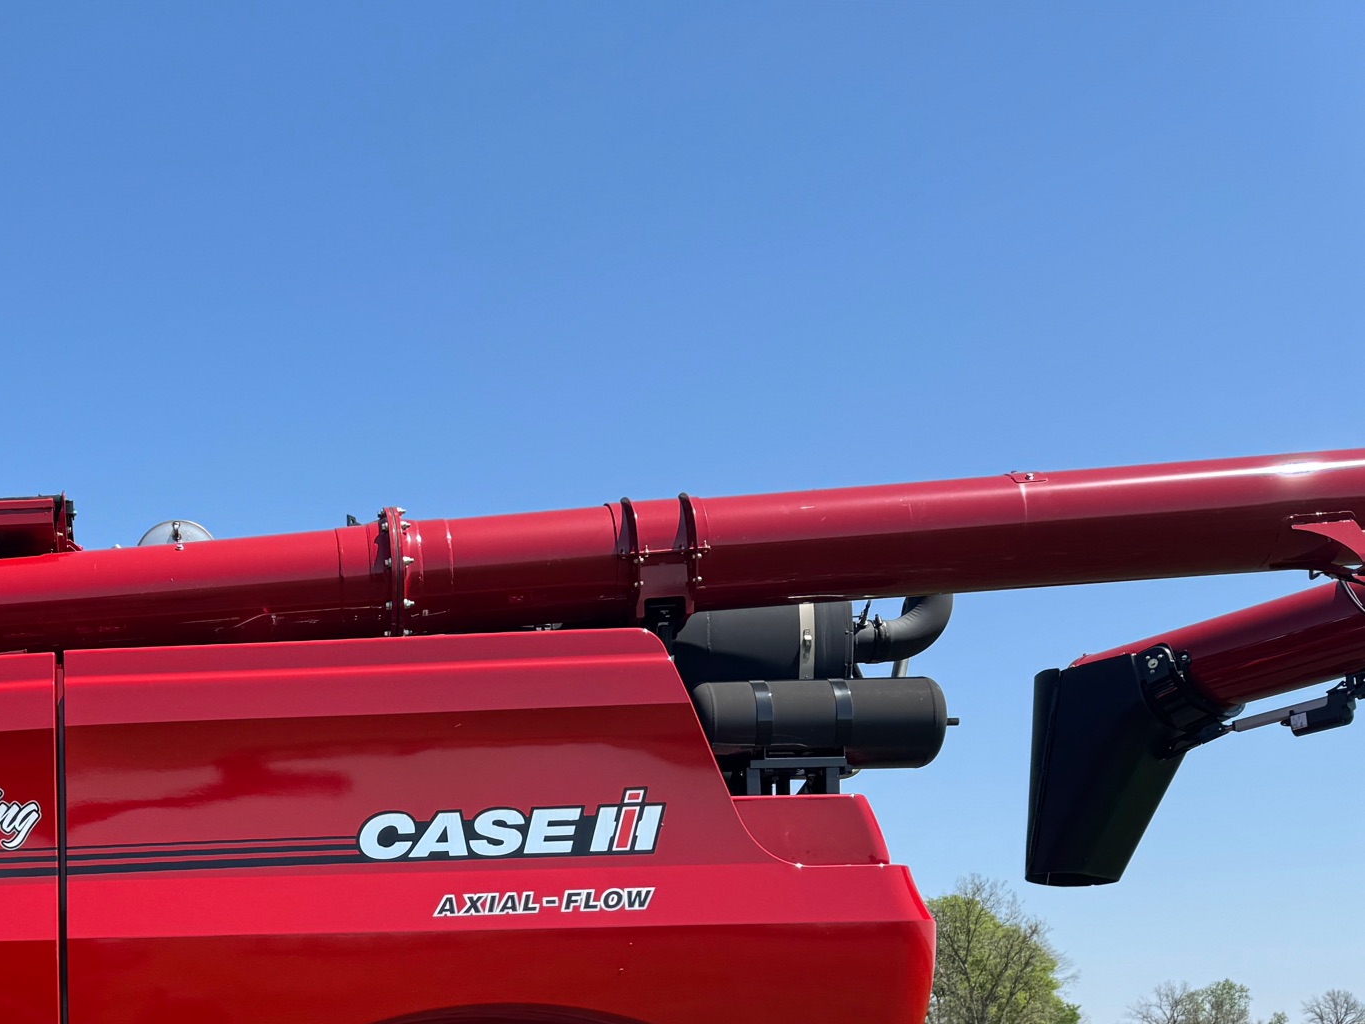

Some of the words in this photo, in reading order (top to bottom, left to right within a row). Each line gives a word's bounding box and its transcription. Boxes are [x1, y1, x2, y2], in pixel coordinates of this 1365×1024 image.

[359, 805, 584, 860] CASE
[589, 786, 667, 855] IH
[433, 886, 655, 916] AXIAL-FLOW
